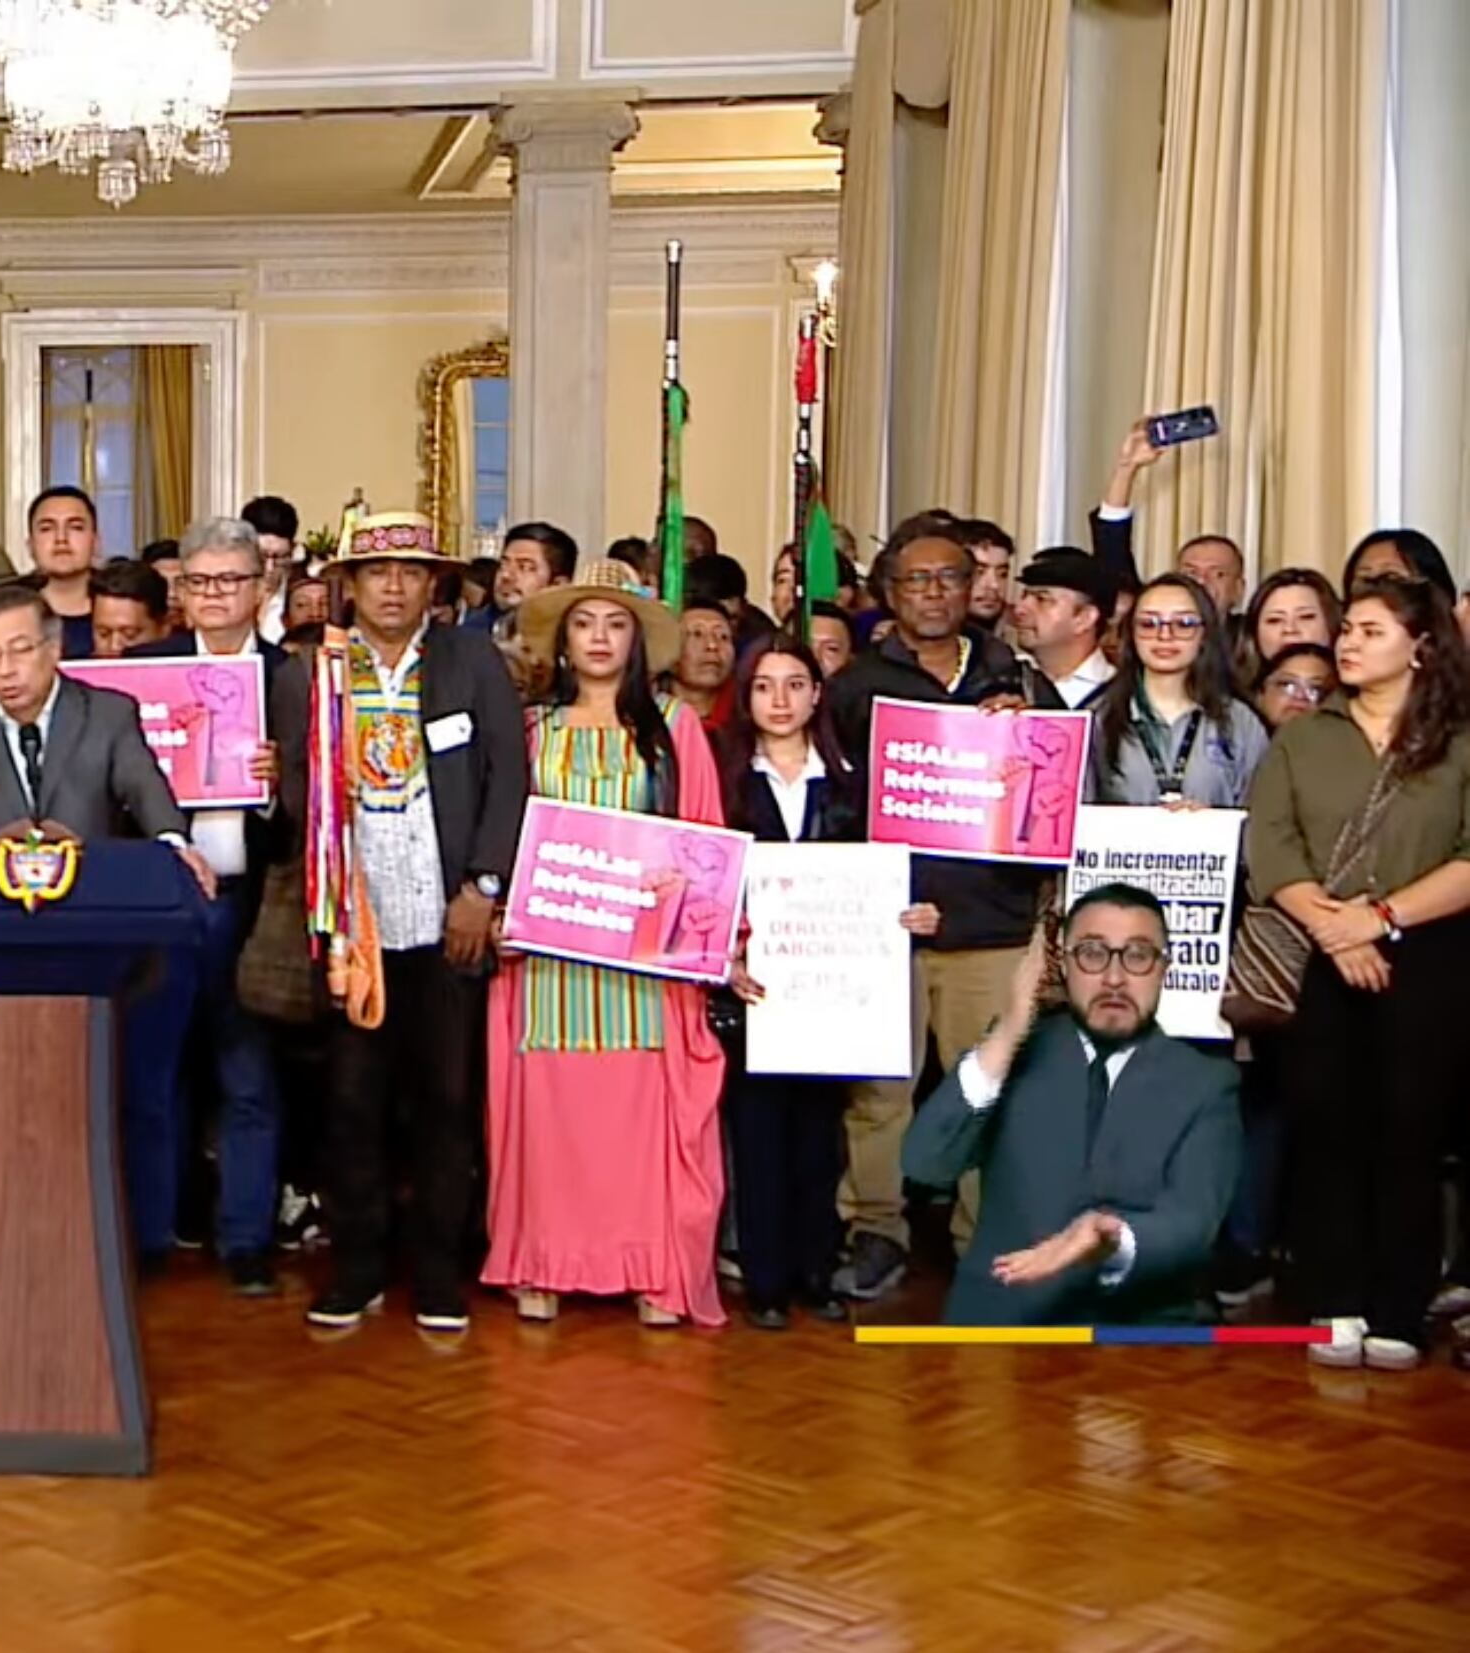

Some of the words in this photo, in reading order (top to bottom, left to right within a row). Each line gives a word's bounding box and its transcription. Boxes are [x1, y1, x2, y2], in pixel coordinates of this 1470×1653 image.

[884, 769, 1006, 798] Reformas
[883, 796, 985, 825] Sociales
[1074, 850, 1099, 869] No
[532, 867, 656, 907] Reformas
[527, 895, 634, 932] Sociales
[1163, 902, 1220, 932] bar
[1166, 938, 1221, 965] rato
[1164, 969, 1221, 994] dizaje
